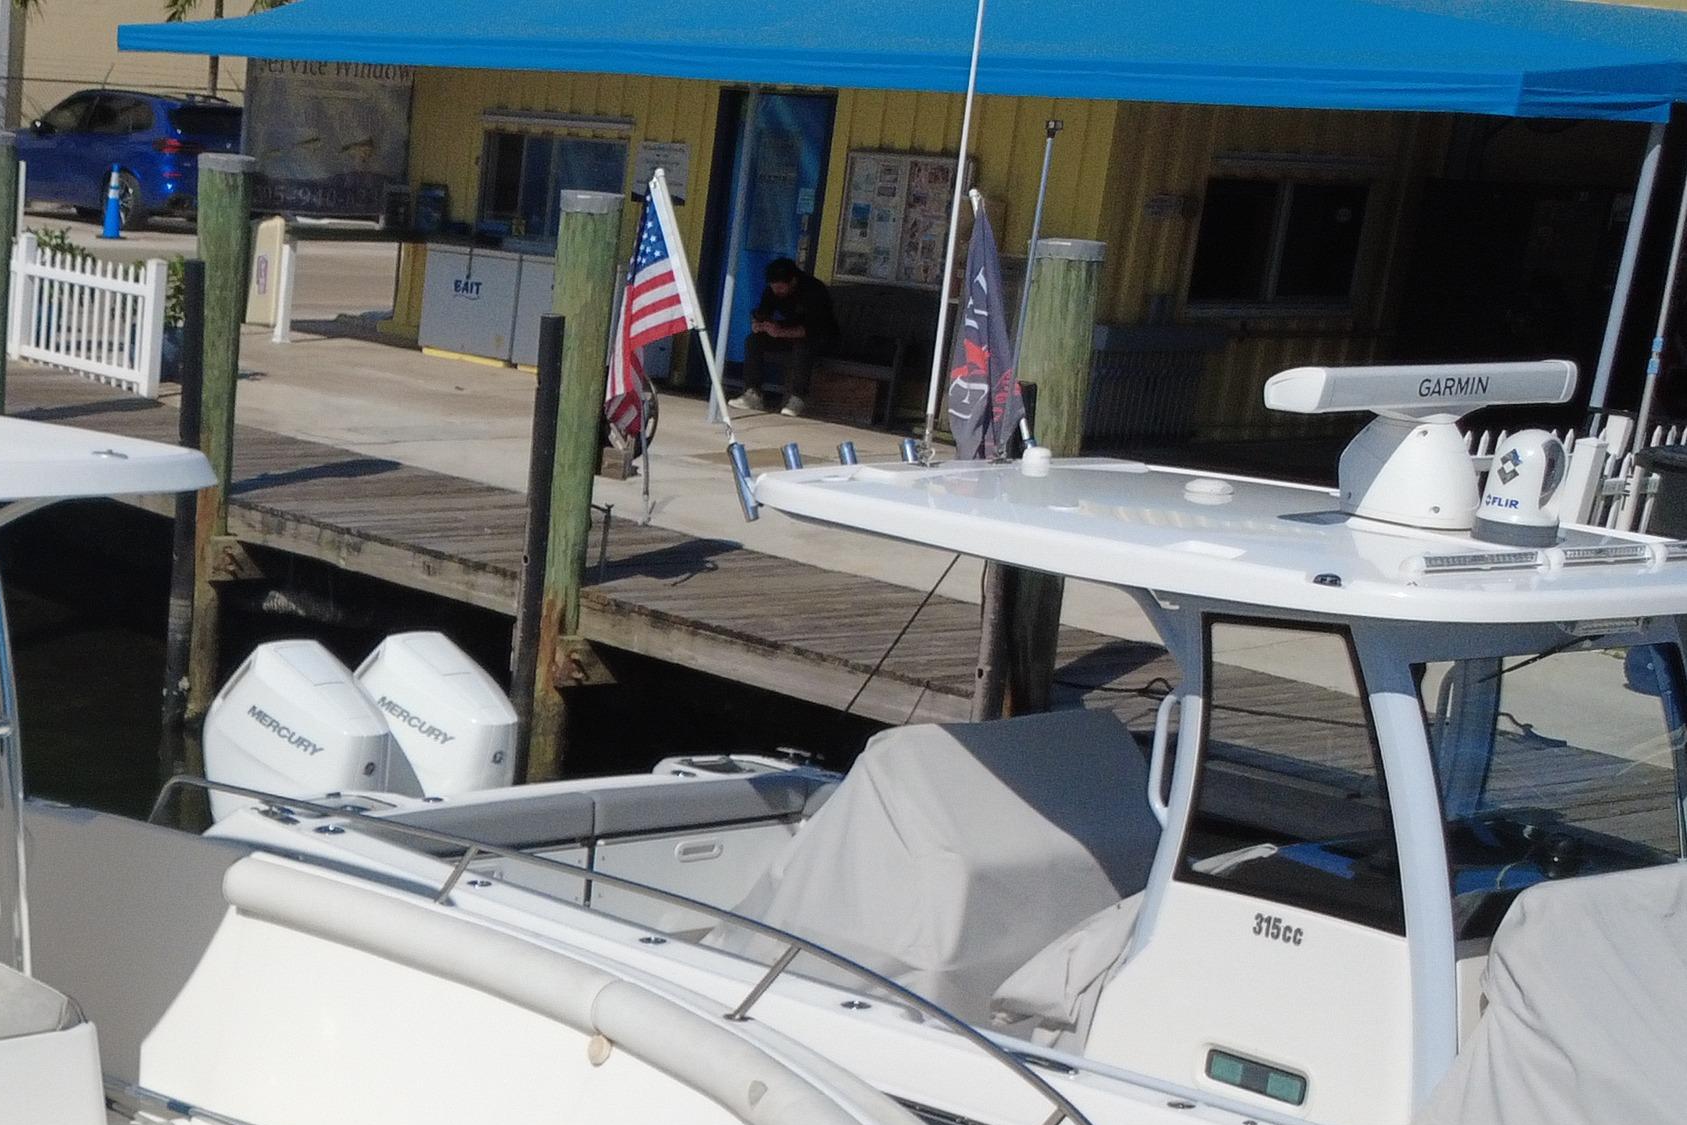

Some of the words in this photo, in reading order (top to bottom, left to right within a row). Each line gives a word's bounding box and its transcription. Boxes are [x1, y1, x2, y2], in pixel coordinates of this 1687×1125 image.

[260, 60, 328, 76] ervice
[454, 279, 483, 294] BAIT
[1418, 376, 1490, 398] GARMIN
[1491, 496, 1519, 510] FLIR
[248, 705, 324, 757] MERCURY
[377, 696, 455, 746] MERCURY
[1253, 912, 1304, 947] 315cc
